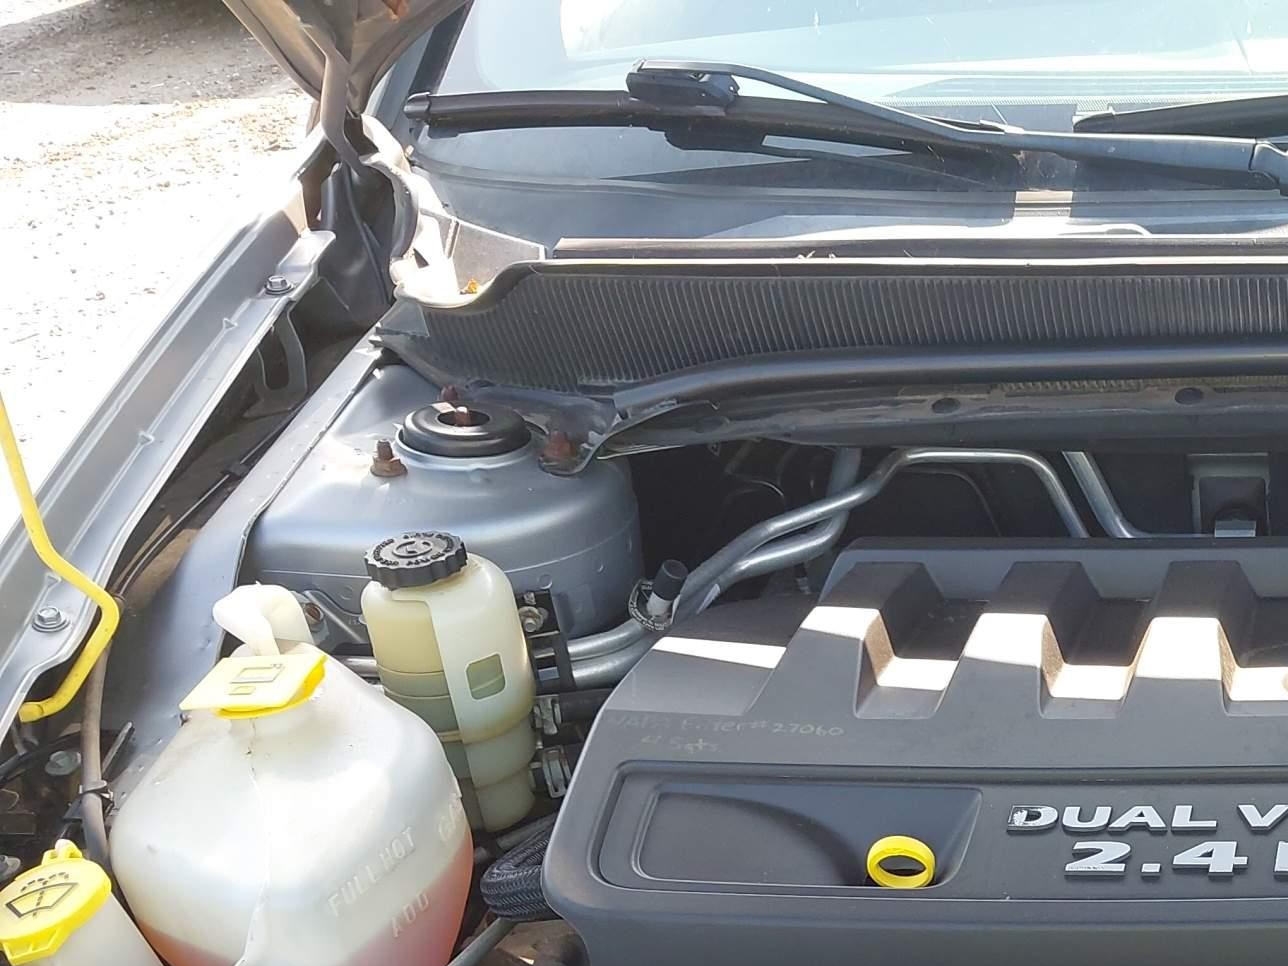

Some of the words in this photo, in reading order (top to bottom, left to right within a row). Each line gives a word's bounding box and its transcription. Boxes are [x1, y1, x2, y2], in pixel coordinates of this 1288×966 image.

[1006, 803, 1218, 833] DUAL
[327, 864, 381, 918] FULL
[379, 826, 416, 872] HOT
[1064, 840, 1248, 880] 2.4
[390, 891, 430, 938] ADD
